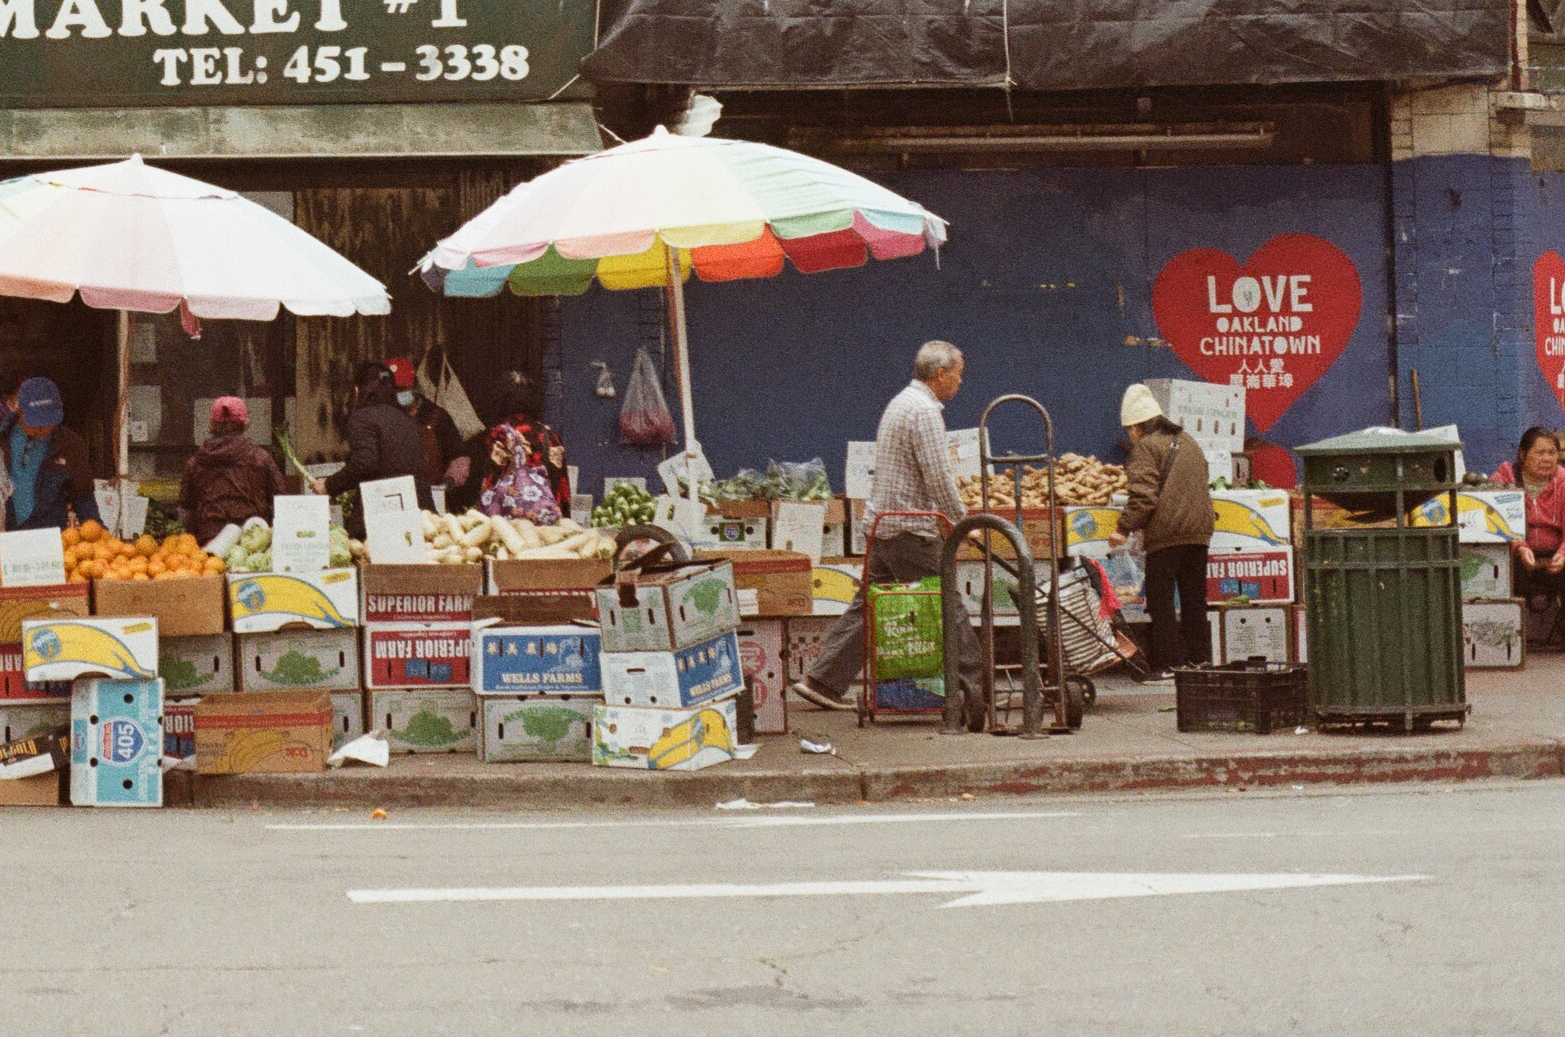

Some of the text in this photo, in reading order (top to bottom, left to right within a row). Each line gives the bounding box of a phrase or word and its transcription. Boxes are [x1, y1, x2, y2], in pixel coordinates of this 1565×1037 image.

[153, 47, 268, 87] TEL:
[1207, 274, 1313, 314] LOVE
[1216, 315, 1303, 333] OAKLAND
[1200, 335, 1321, 356] CHINATOWN
[1226, 559, 1287, 579] SUPERIOR
[368, 594, 436, 613] SUPERIOR
[375, 638, 471, 659] UPERIOR FARM
[501, 672, 584, 685] WELLS FARMS
[118, 723, 136, 760] 405
